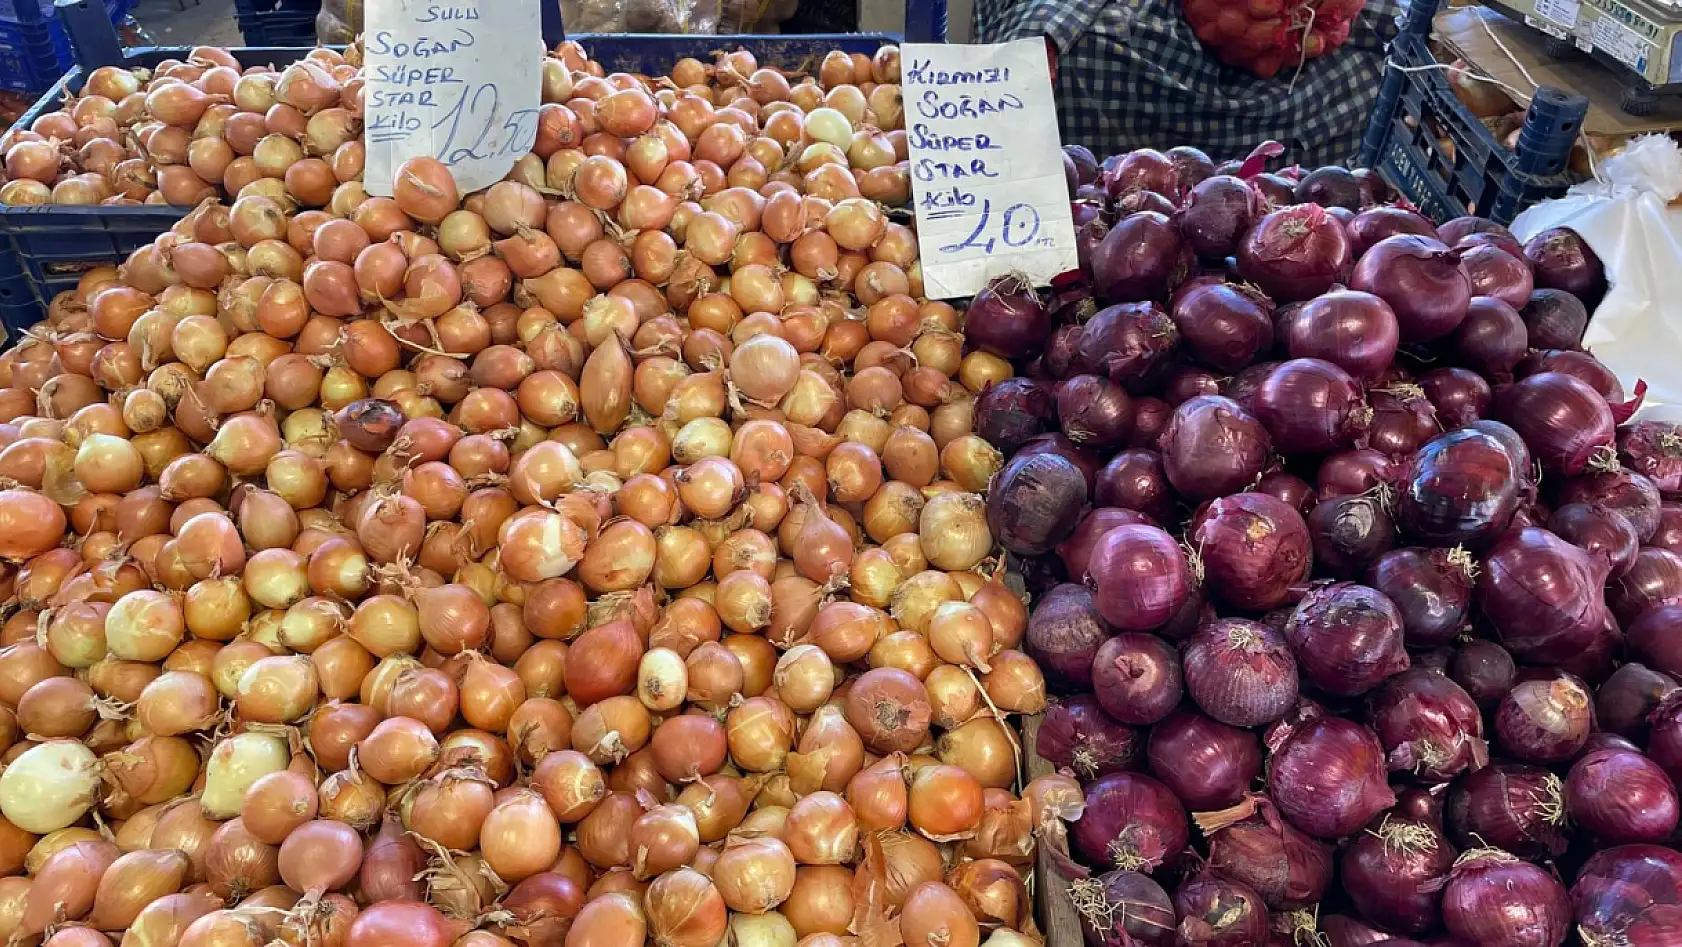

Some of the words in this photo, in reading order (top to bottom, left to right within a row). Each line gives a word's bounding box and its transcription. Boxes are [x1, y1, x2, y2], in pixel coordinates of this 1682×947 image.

[366, 28, 475, 58] SOĞAN
[369, 64, 464, 87] SÜPER
[369, 90, 438, 107] STAR
[917, 90, 1024, 119] SOĞAN
[908, 123, 1003, 151] SÜPER
[914, 158, 999, 181] STAR
